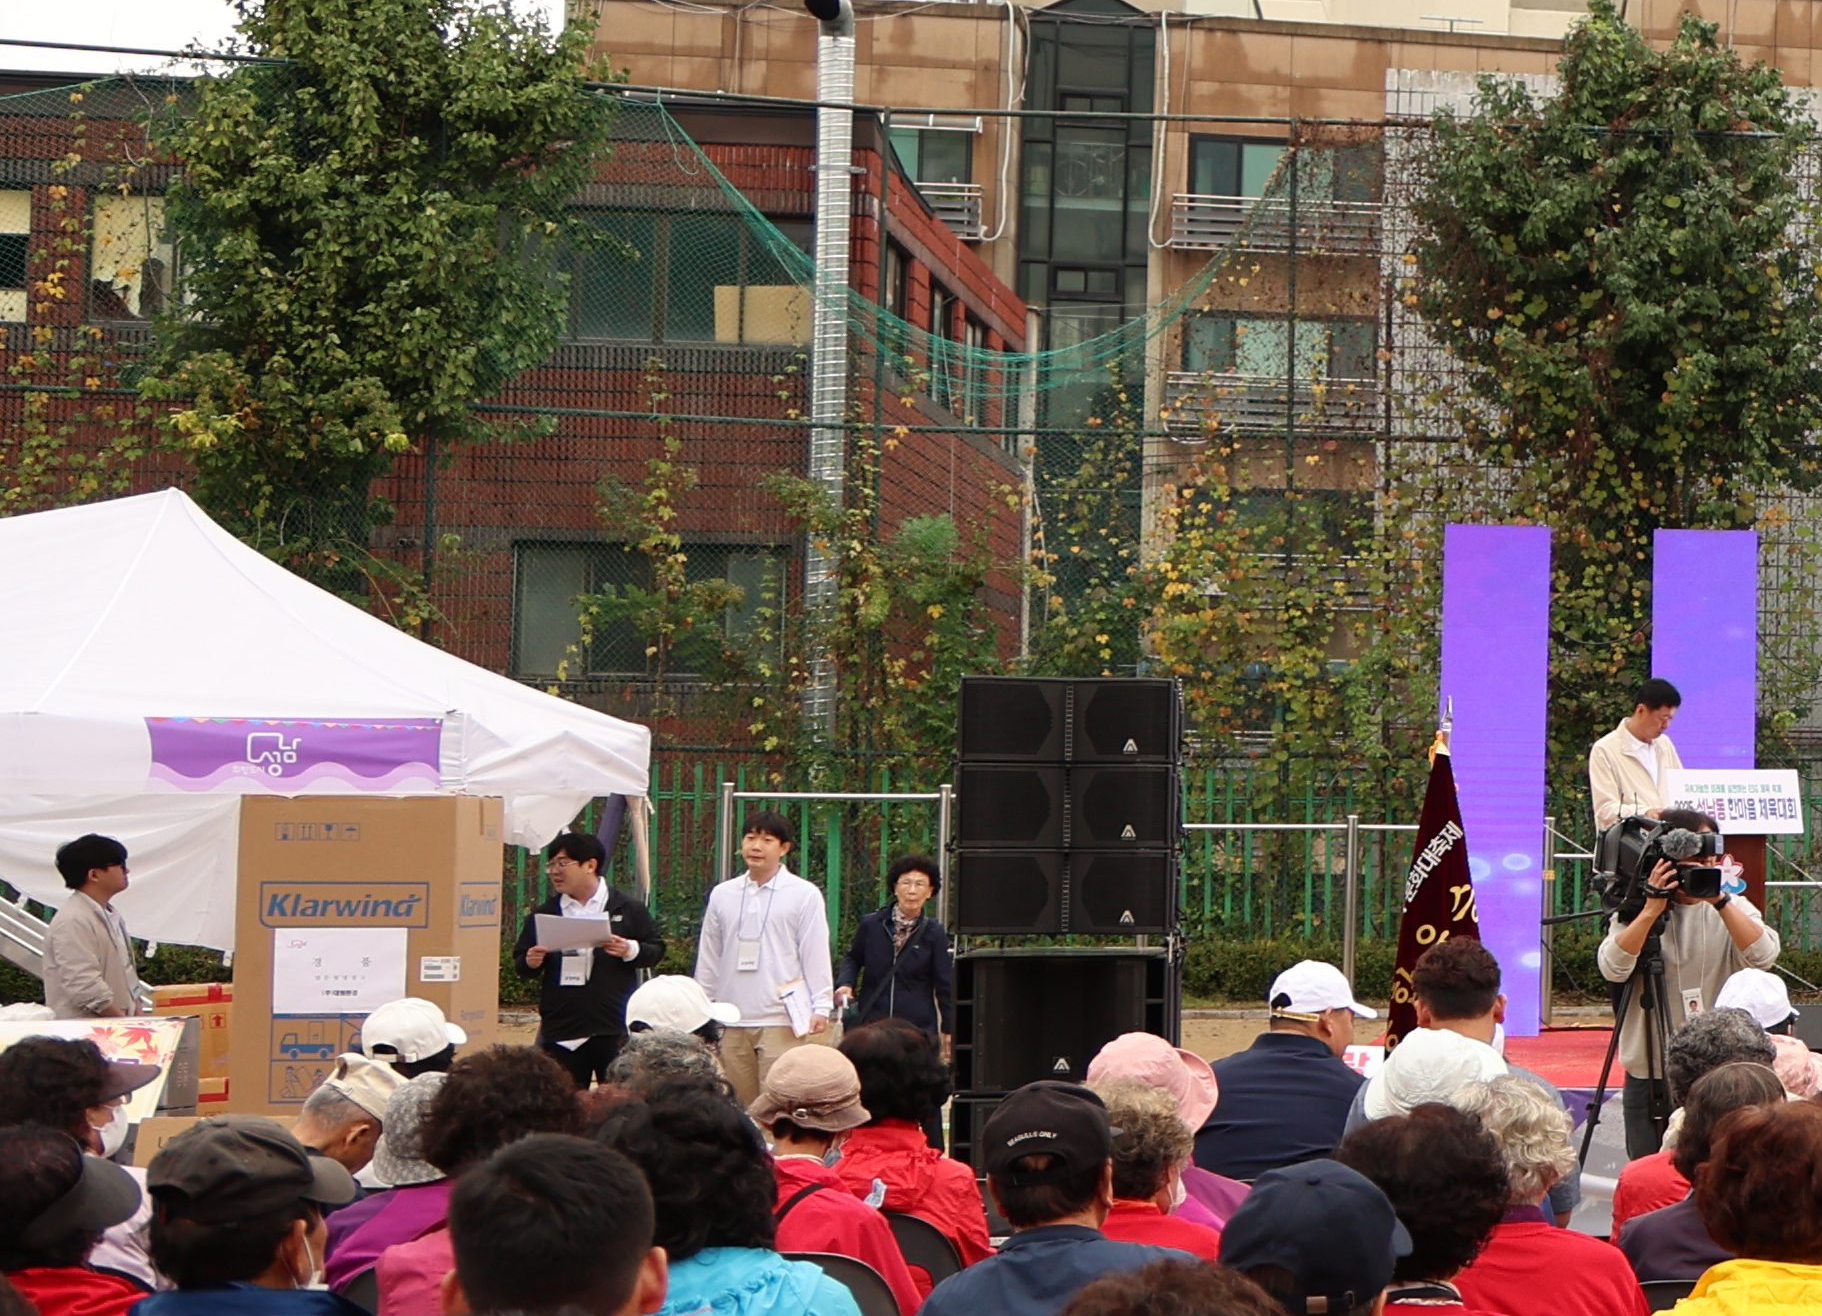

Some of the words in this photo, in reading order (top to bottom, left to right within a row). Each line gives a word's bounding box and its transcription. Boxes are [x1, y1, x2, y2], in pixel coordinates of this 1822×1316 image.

[1727, 797, 1757, 820] 한마음
[1758, 797, 1798, 820] 체육대회
[267, 893, 421, 917] Klarwind
